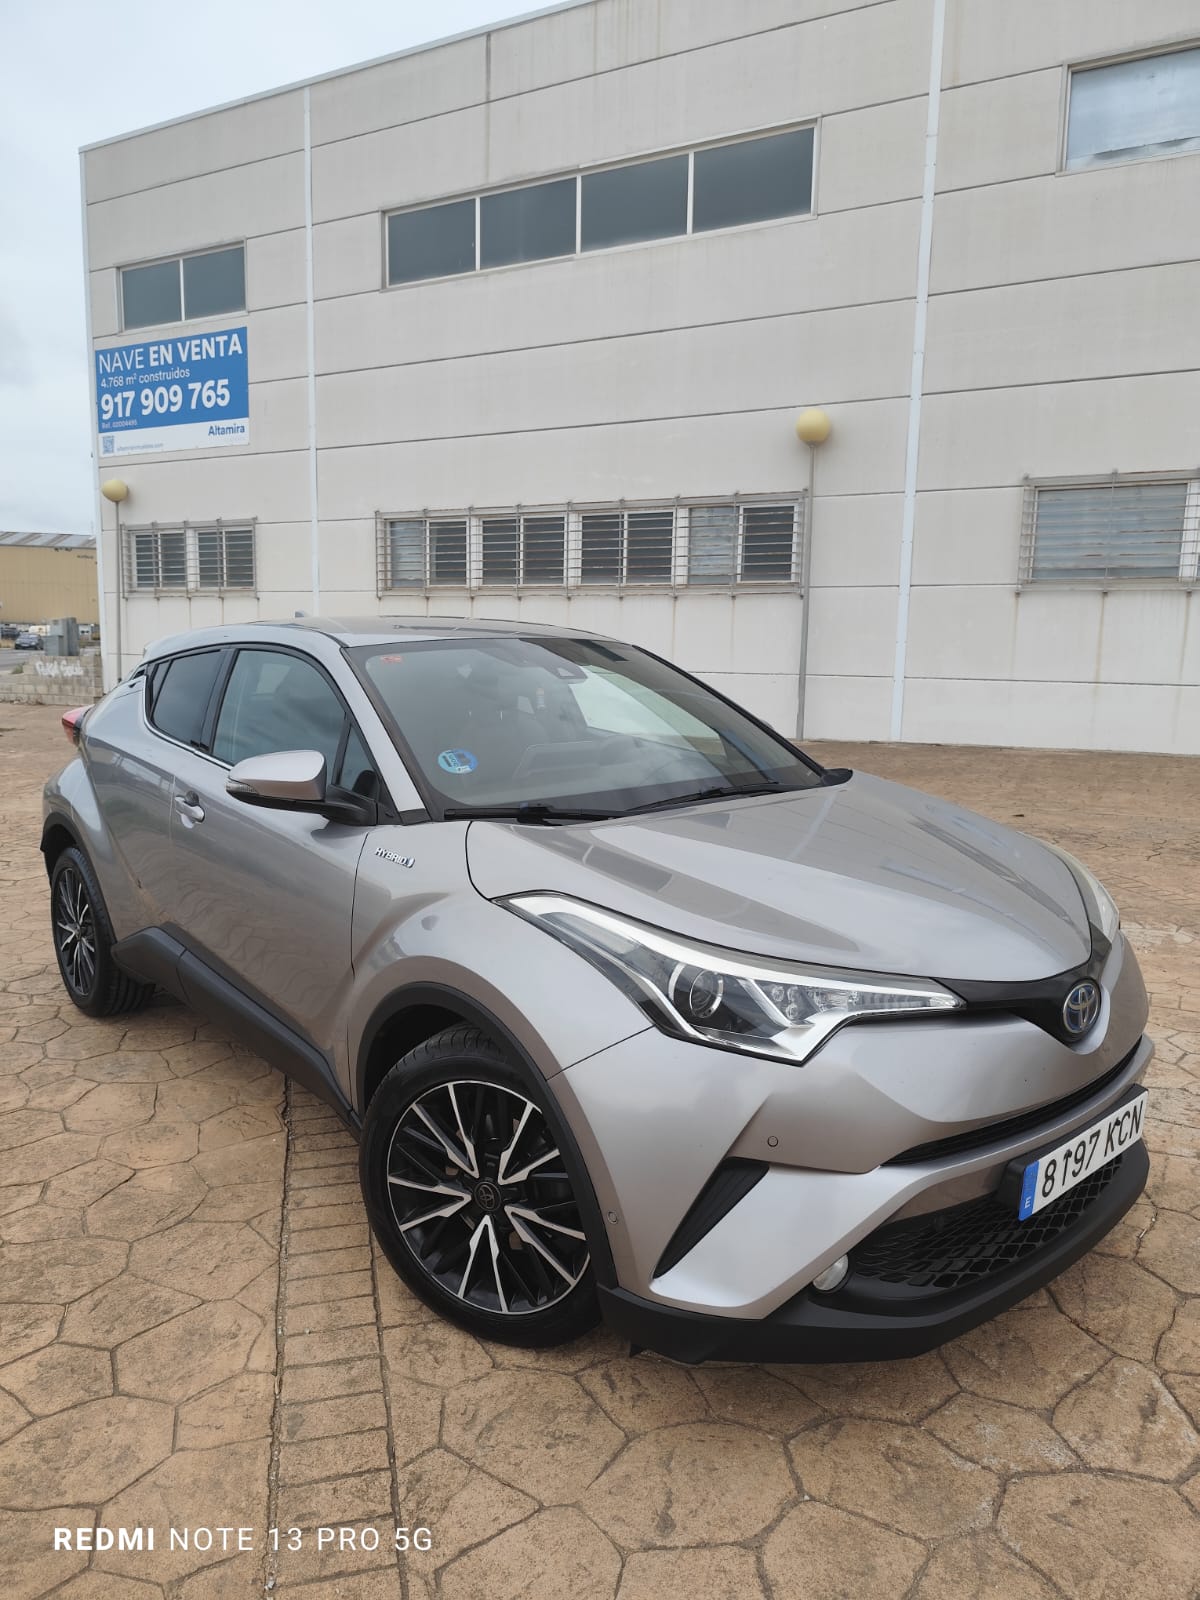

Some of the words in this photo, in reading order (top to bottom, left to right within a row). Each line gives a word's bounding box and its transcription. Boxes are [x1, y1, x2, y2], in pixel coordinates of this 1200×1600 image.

[99, 348, 145, 374] NAVE
[149, 343, 173, 367] EN
[177, 333, 243, 363] VENTA
[100, 375, 124, 389] 4.768
[139, 367, 190, 384] construidos
[101, 390, 136, 421] 917
[140, 384, 183, 416] 909
[188, 378, 231, 410] 765
[208, 422, 246, 437] Altamira
[375, 847, 408, 866] HYBRID
[1041, 1129, 1101, 1198] 8197
[1104, 1100, 1144, 1158] KCN
[1024, 1196, 1031, 1209] E
